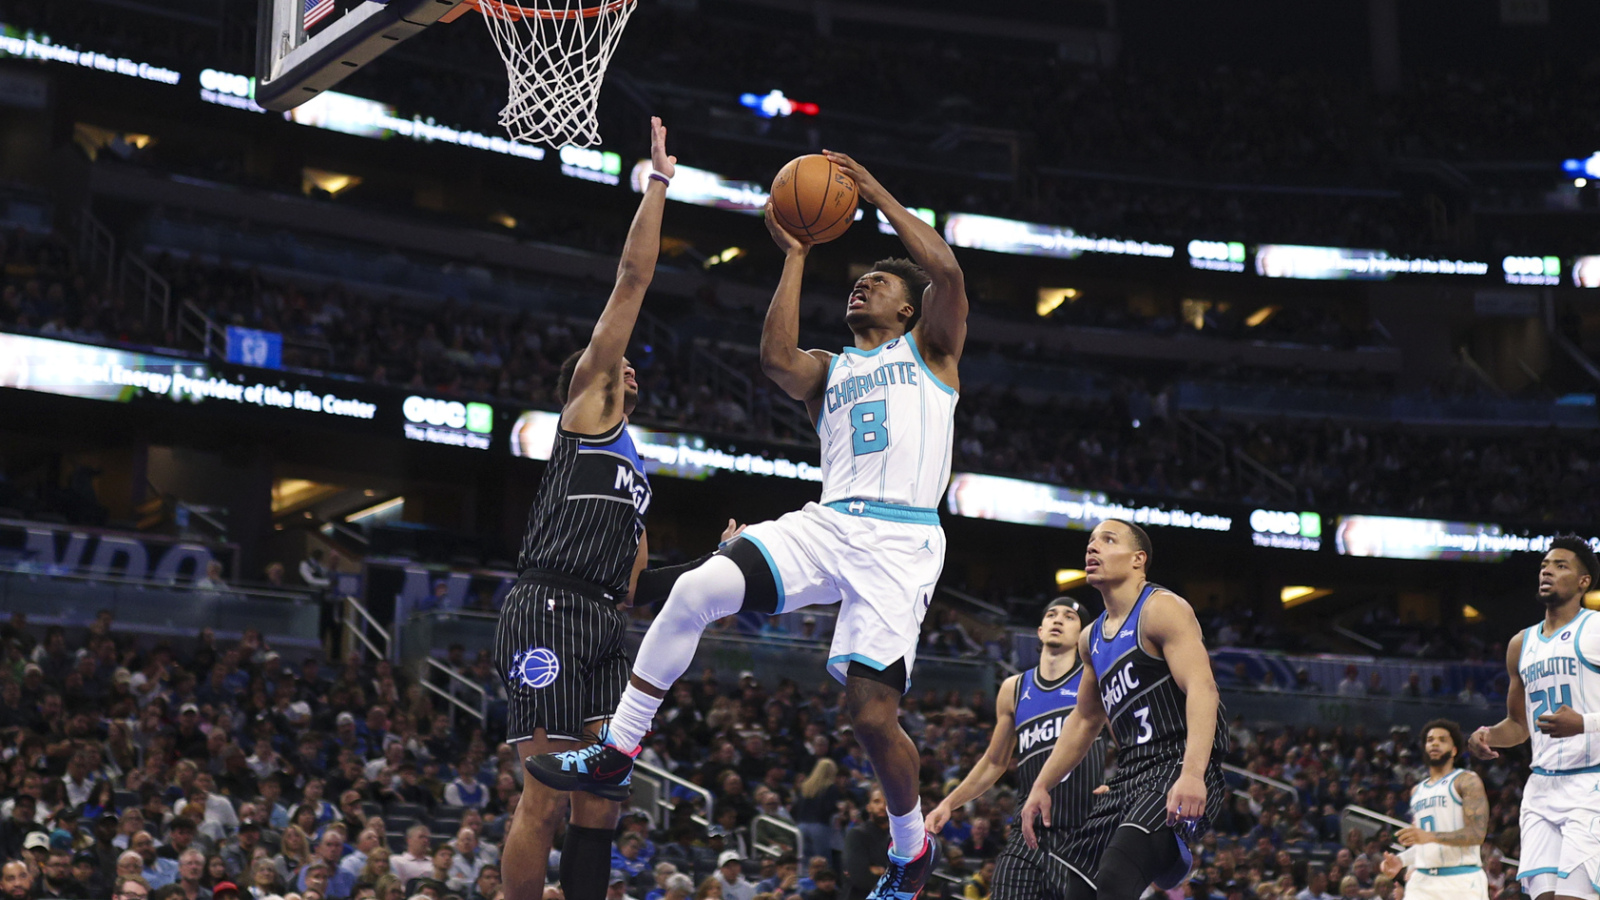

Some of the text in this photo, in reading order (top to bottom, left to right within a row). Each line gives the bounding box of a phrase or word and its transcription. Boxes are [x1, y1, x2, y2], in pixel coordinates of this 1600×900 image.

[111, 363, 172, 394] Energy
[172, 372, 243, 401] Provider
[244, 384, 264, 405] of
[264, 386, 293, 408] the
[293, 390, 321, 411] Kia
[322, 395, 376, 418] Center
[825, 361, 918, 414] CHARLOTTE
[850, 399, 889, 457] 8
[679, 445, 735, 470] Provider
[735, 453, 751, 472] of
[751, 456, 774, 474] the
[797, 462, 822, 480] Cen
[1134, 506, 1149, 524] of
[1149, 508, 1170, 525] the
[1191, 512, 1231, 531] Center
[1478, 532, 1529, 552] Provider
[1019, 716, 1069, 754] MAGI
[1133, 706, 1153, 744] 3
